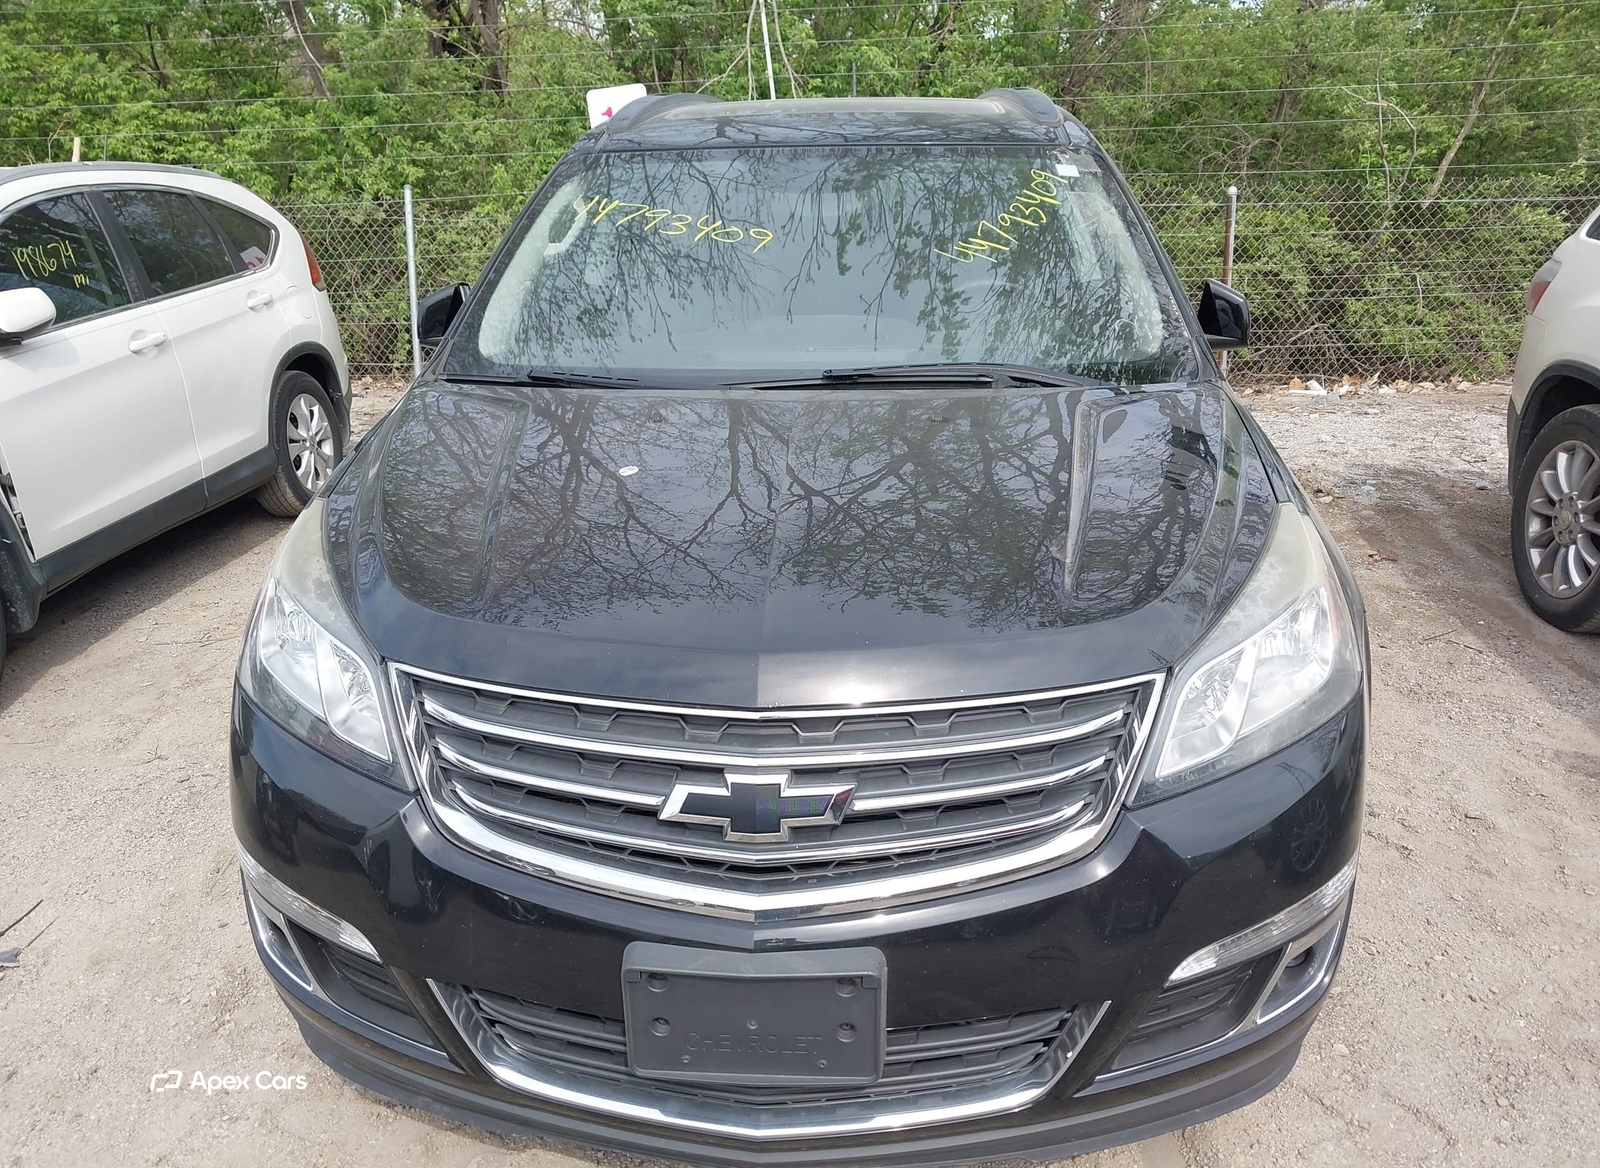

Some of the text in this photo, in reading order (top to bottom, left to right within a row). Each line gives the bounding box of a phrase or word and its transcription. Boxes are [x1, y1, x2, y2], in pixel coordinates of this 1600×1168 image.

[573, 193, 774, 254] 44793409
[933, 168, 1069, 263] 44793409
[11, 239, 77, 281] 198674
[684, 1031, 823, 1055] CHEVROLET
